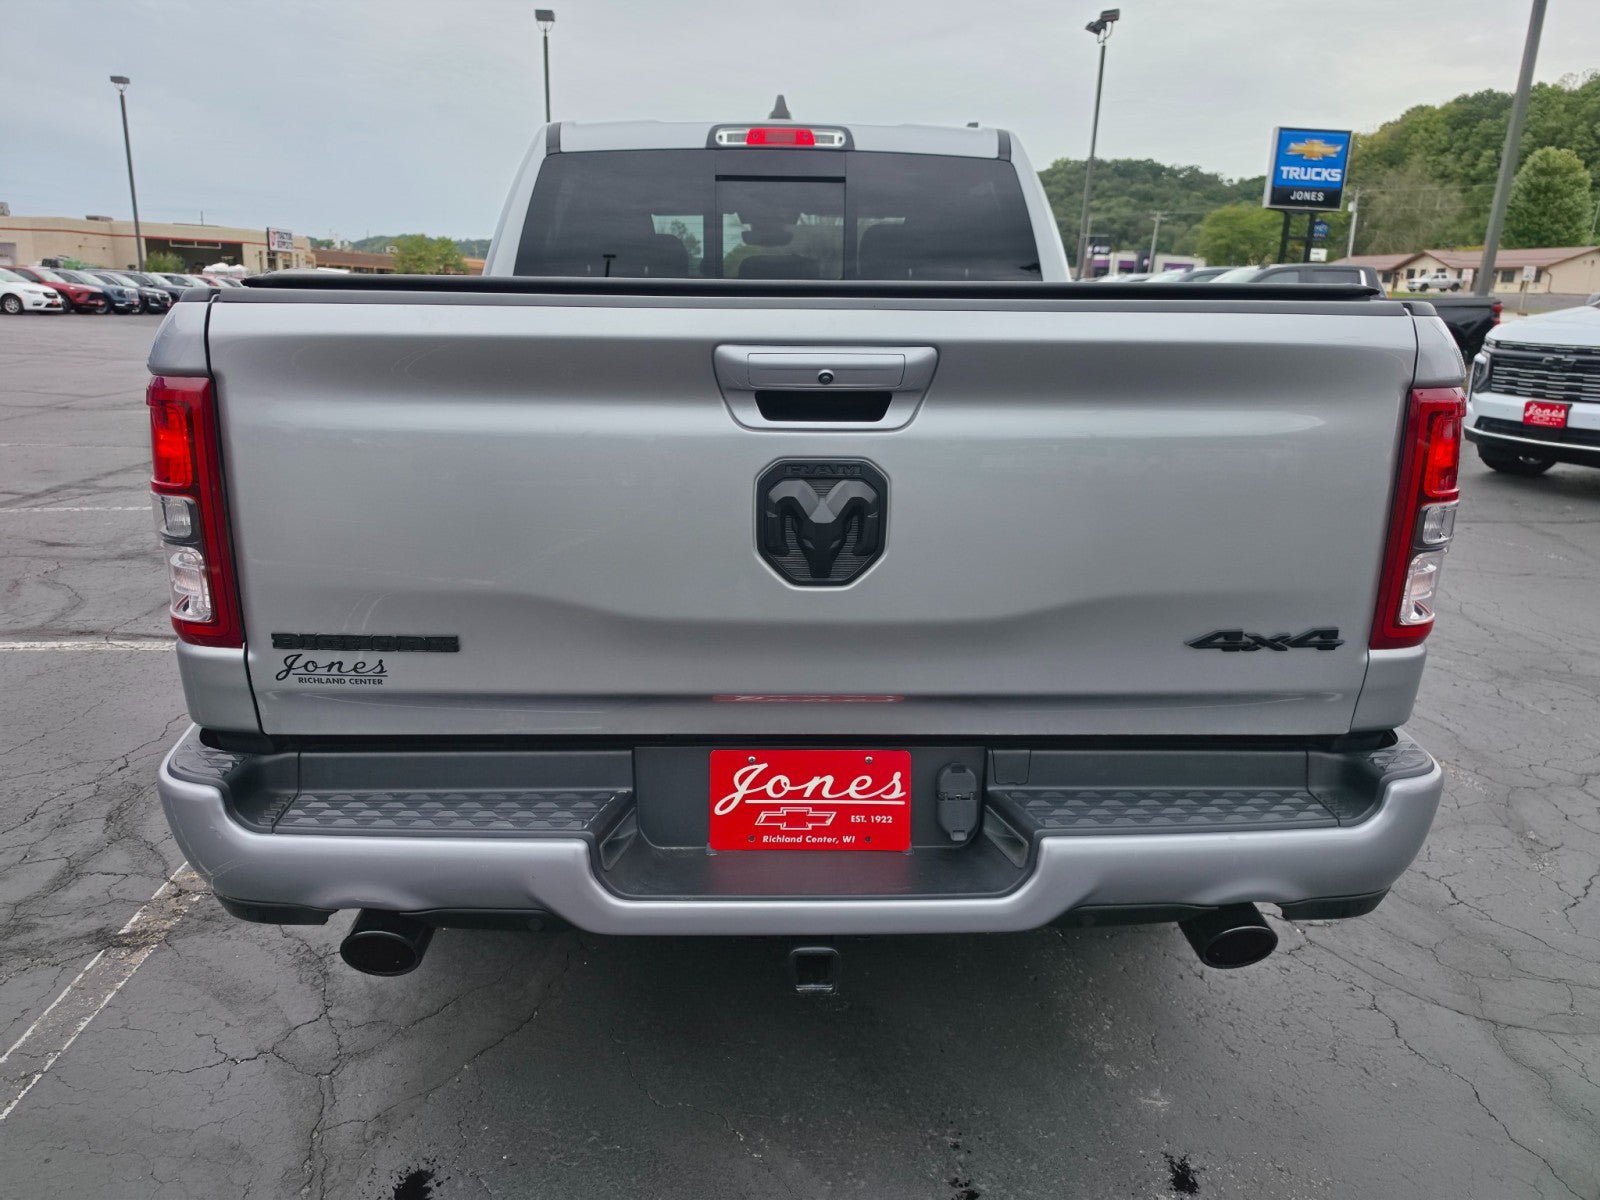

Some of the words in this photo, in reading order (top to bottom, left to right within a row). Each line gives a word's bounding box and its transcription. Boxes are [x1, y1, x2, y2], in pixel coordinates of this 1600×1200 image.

[1280, 166, 1342, 182] TRUCKS
[1290, 190, 1325, 202] JONES
[785, 463, 862, 476] RAM
[275, 653, 389, 682] Jones
[298, 676, 346, 685] RICHLAND
[349, 677, 384, 686] CENTER
[714, 762, 907, 816] Jones
[850, 815, 867, 824] EST.
[870, 815, 893, 824] 1922
[762, 835, 803, 844] Richland
[805, 835, 839, 845] Center,
[842, 835, 856, 844] WI
